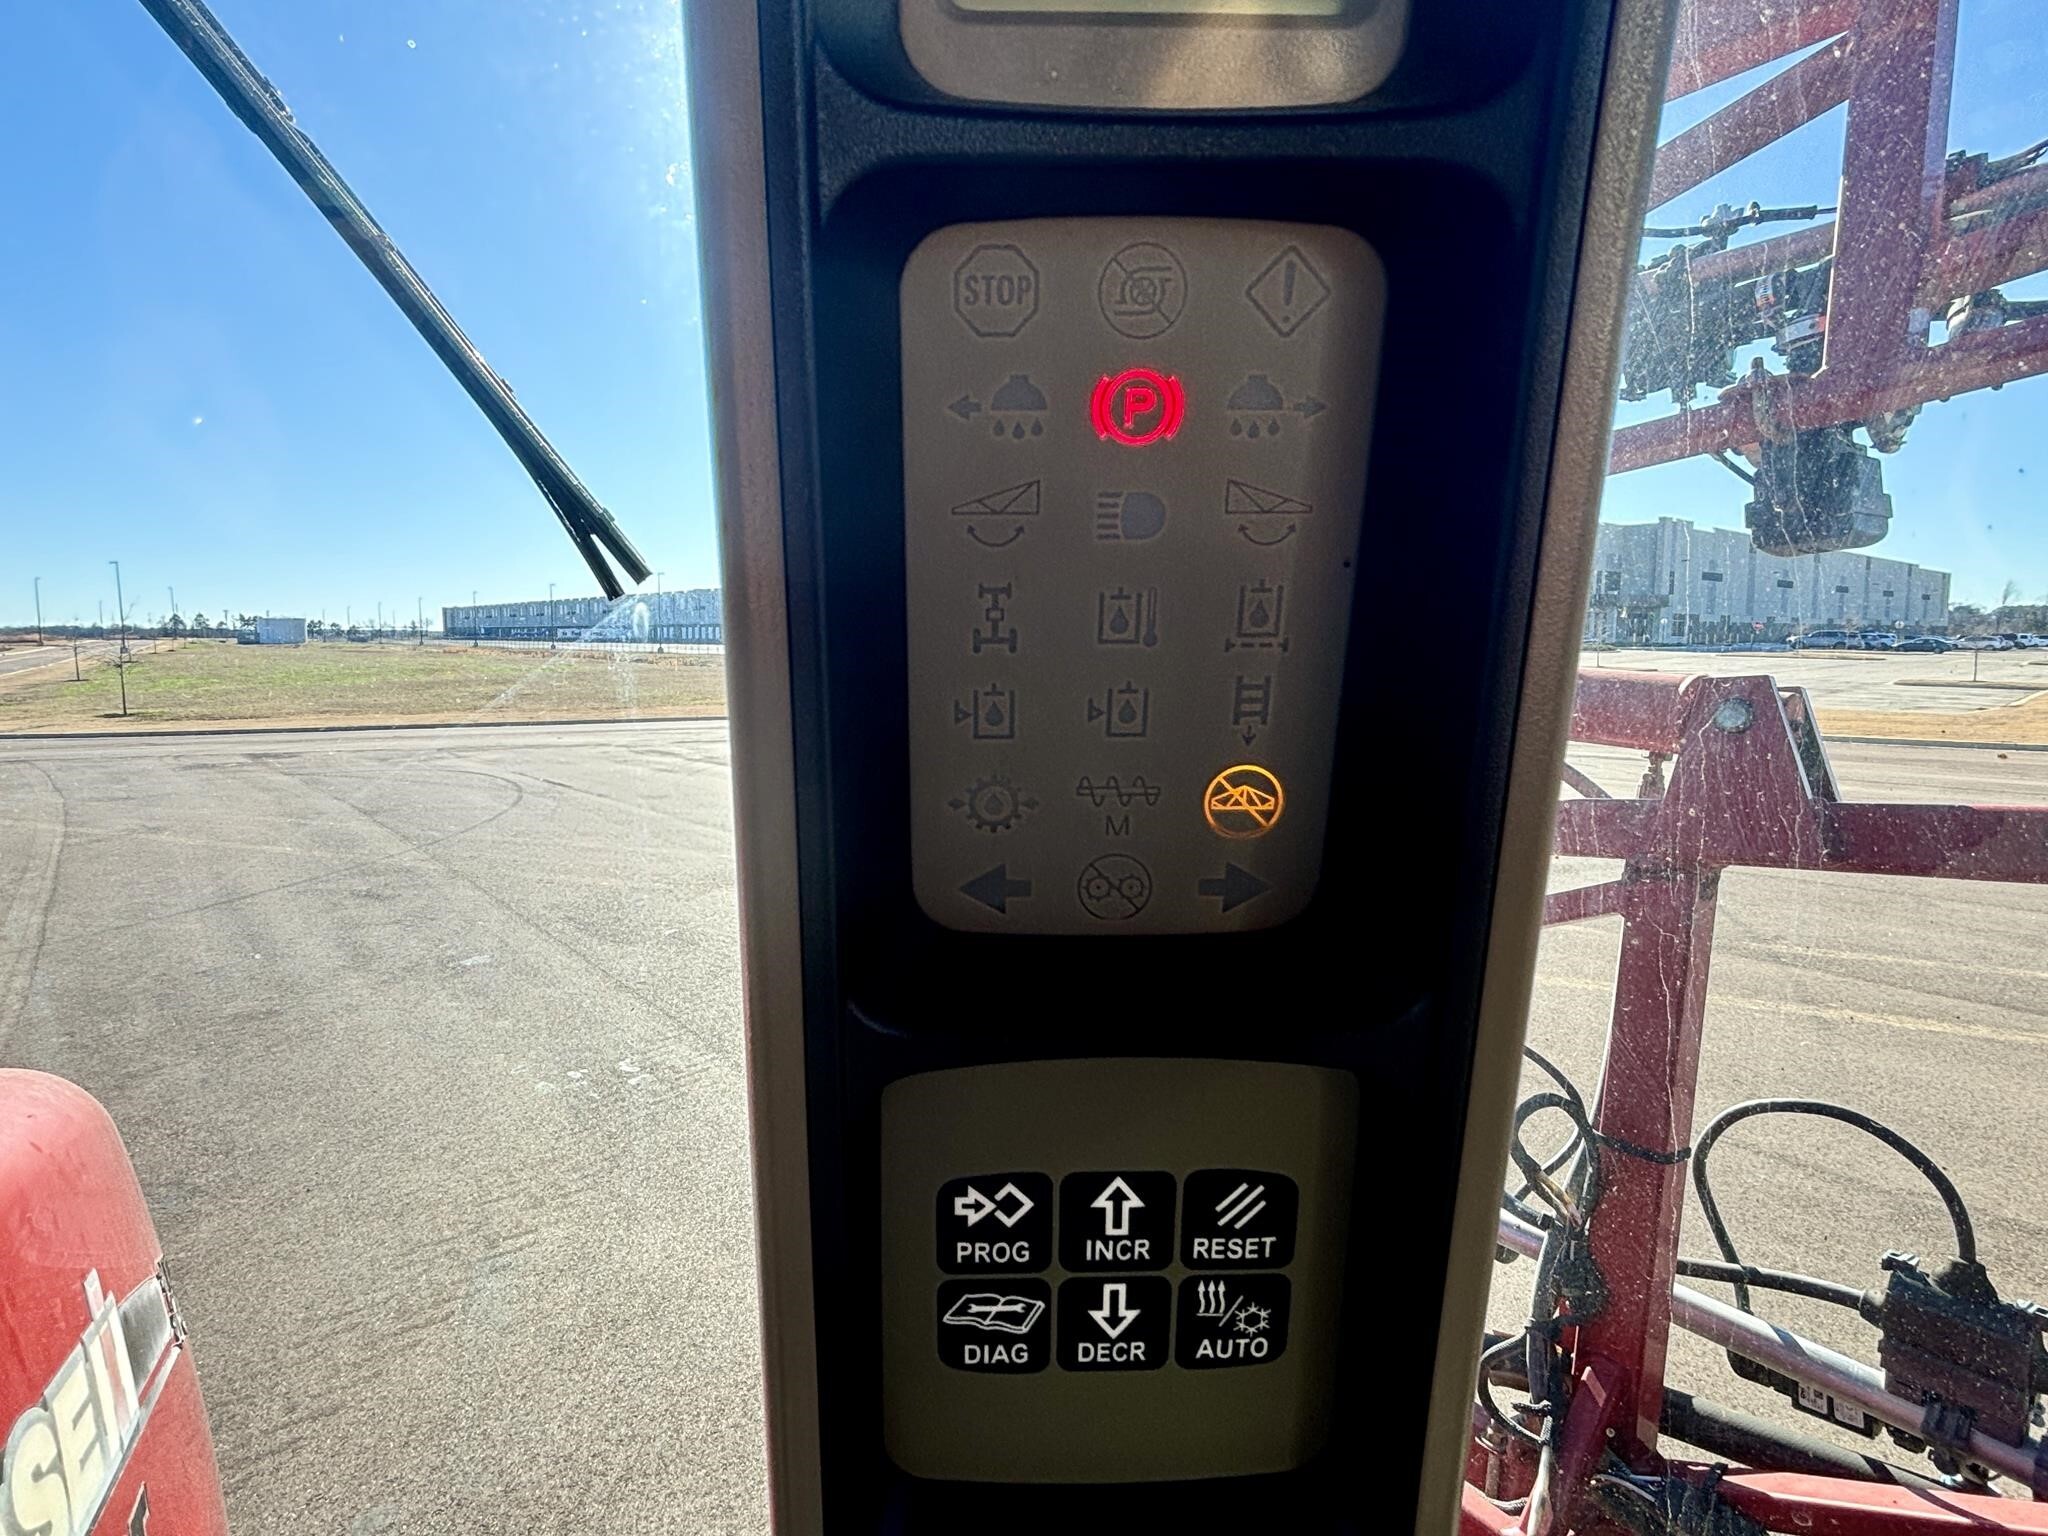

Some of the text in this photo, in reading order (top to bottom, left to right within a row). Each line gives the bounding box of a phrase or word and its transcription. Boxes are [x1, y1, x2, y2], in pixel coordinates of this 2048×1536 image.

[964, 274, 1033, 306] STOP
[1105, 814, 1129, 836] M
[957, 1242, 1029, 1263] PROG
[1087, 1239, 1149, 1260] INCR
[1193, 1237, 1276, 1258] RESET
[965, 1344, 1028, 1363] DIAG
[1078, 1342, 1145, 1362] DECR
[1196, 1338, 1268, 1358] AUTO
